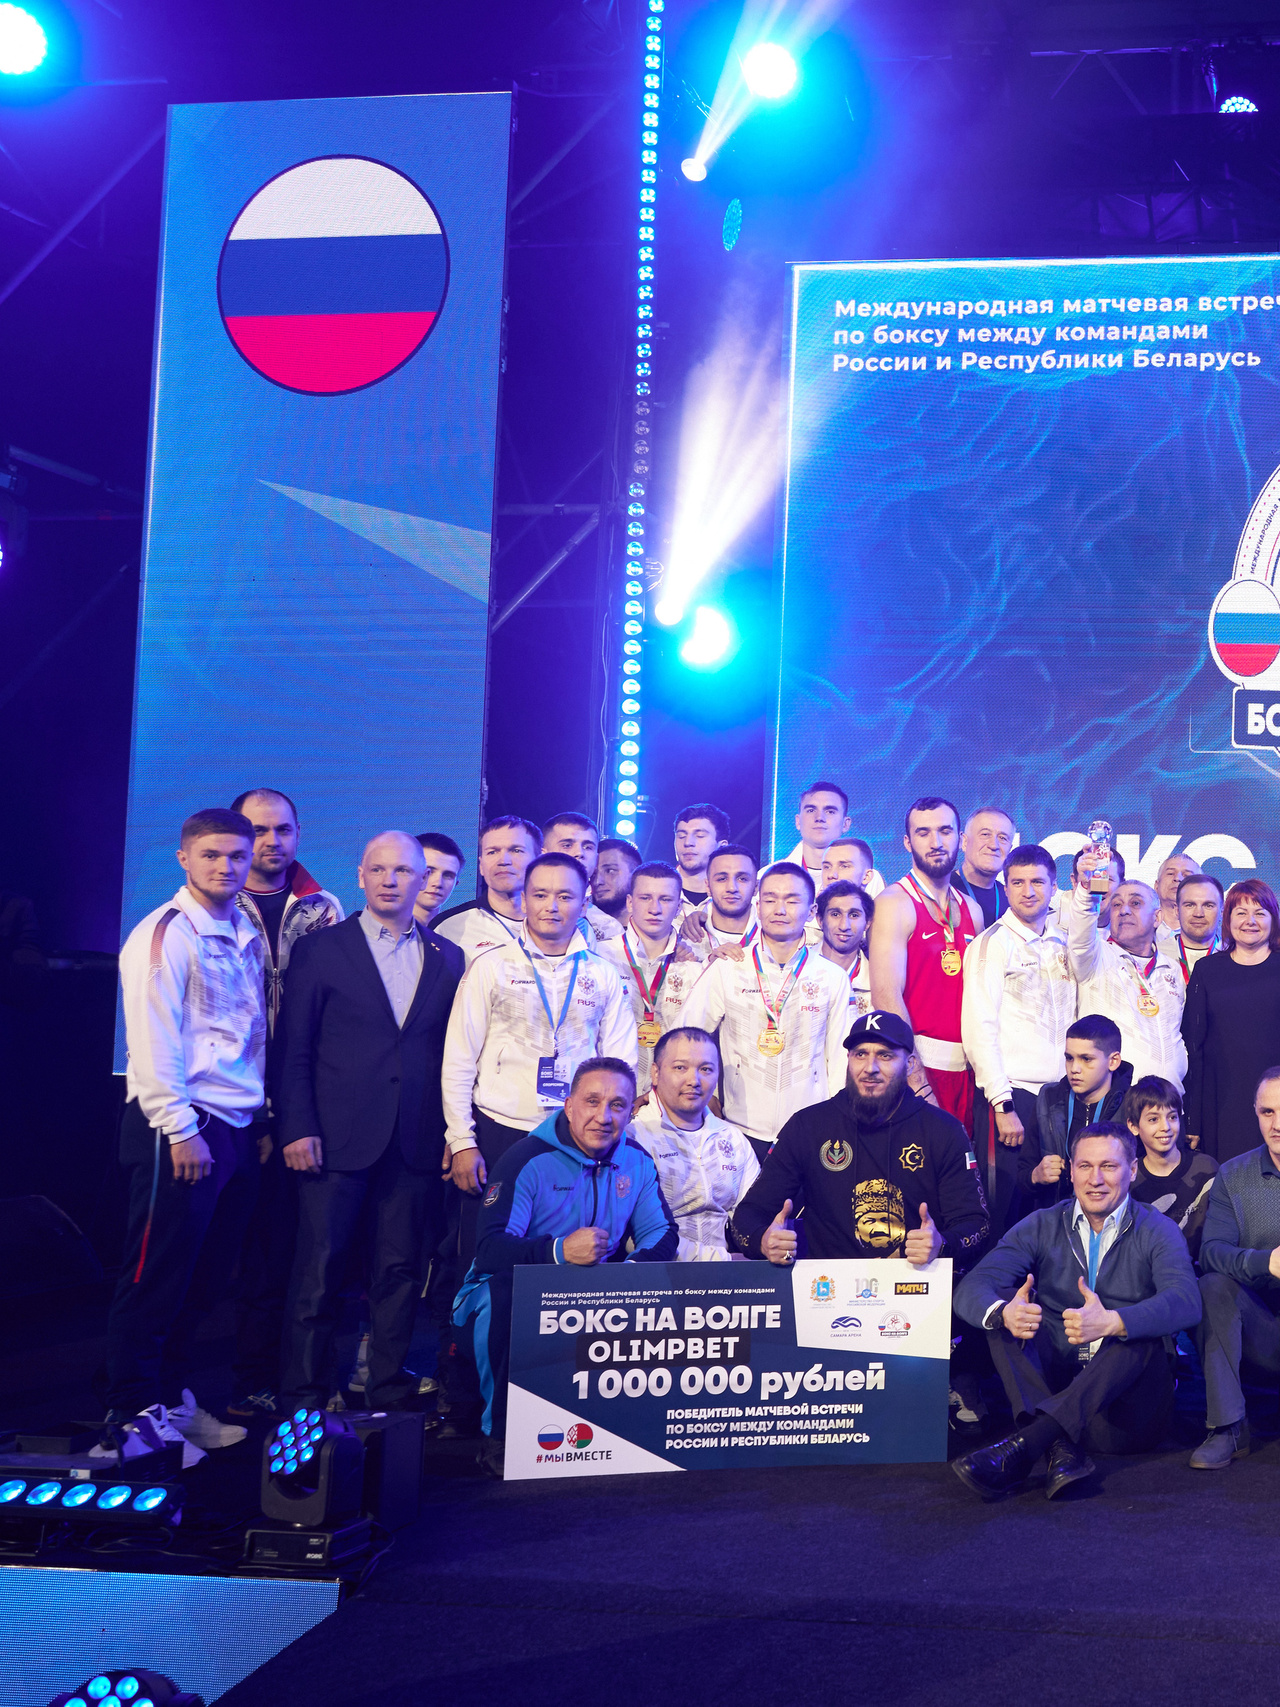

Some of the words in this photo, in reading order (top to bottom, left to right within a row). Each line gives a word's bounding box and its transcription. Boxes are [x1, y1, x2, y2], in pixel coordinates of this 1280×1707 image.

[835, 298, 1054, 321] Международная
[1063, 296, 1189, 314] матчевая
[833, 330, 865, 344] по
[873, 325, 950, 347] боксу
[958, 325, 1047, 346] между
[1055, 324, 1209, 342] командами
[833, 354, 927, 372] России
[936, 356, 951, 370] и
[961, 350, 1124, 374] Республики
[1133, 349, 1262, 371] Беларусь
[1250, 503, 1279, 574] МЕЖДУНАРОДНАЯ
[577, 999, 596, 1008] RUS
[665, 996, 682, 1006] RUS
[801, 1005, 820, 1013] RUS
[865, 1014, 881, 1031] K
[541, 1290, 604, 1299] Международная
[605, 1289, 641, 1297] матчевая
[642, 1288, 672, 1297] встреча
[684, 1287, 706, 1296] боксу
[708, 1287, 732, 1295] между
[734, 1286, 776, 1295] командами
[896, 1284, 927, 1294] МАТЧ!
[541, 1298, 569, 1306] России
[577, 1297, 624, 1306] Республики
[625, 1297, 661, 1305] Беларусь
[539, 1307, 629, 1335] БОКС
[635, 1307, 678, 1332] НА
[684, 1304, 782, 1331] ВОЛГЕ
[588, 1336, 740, 1363] OLIMPBET
[572, 1370, 590, 1400] 1
[597, 1367, 672, 1399] 000
[680, 1365, 753, 1396] 000
[761, 1362, 886, 1401] рублей
[666, 1407, 743, 1420] ПОБЕДИТЕЛЬ
[745, 1403, 809, 1417] МАТЧЕВОЙ
[811, 1403, 864, 1415] ВСТРЕЧИ
[666, 1424, 685, 1435] ПО
[686, 1422, 728, 1434] БОКСУ
[730, 1420, 775, 1433] МЕЖДУ
[776, 1418, 855, 1431] КОМАНДАМИ
[665, 1438, 719, 1450] РОССИИ
[720, 1437, 729, 1447] И
[731, 1434, 809, 1447] РЕСПУБЛИКИ
[810, 1432, 871, 1445] БЕЛАРУСЬ
